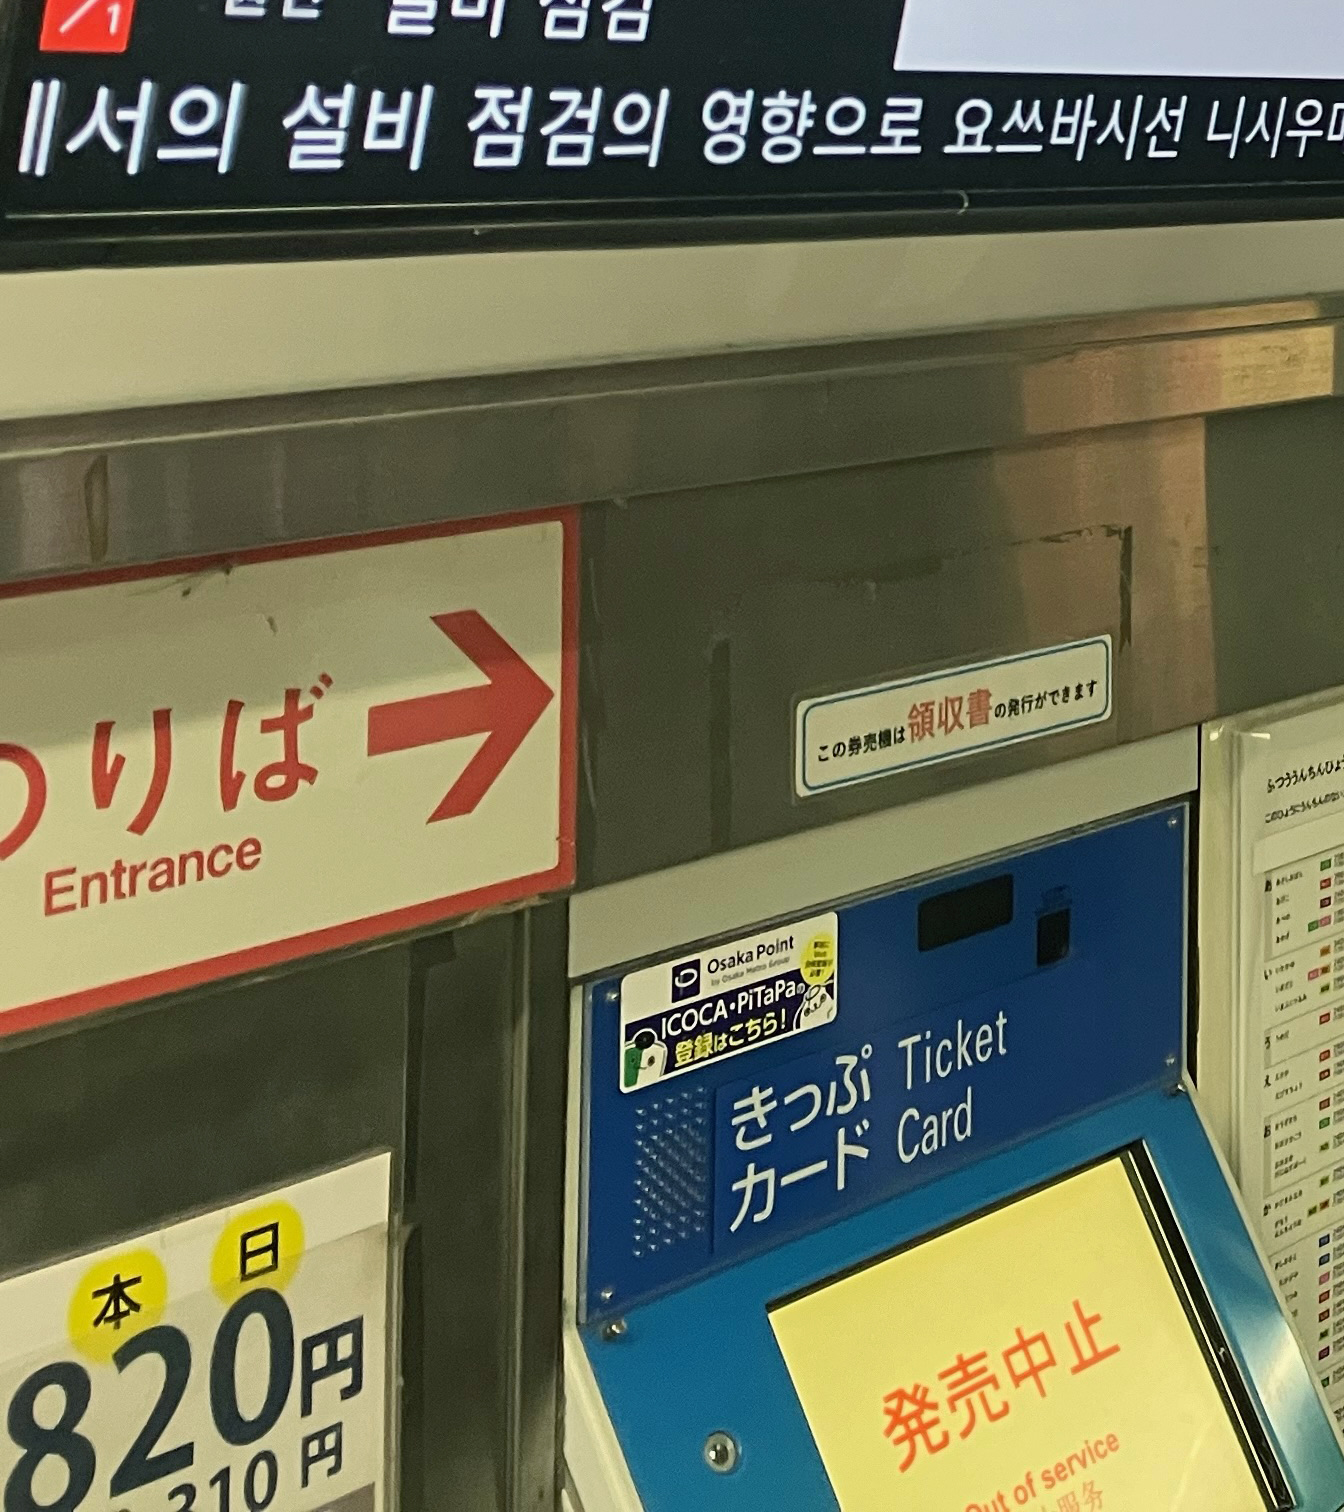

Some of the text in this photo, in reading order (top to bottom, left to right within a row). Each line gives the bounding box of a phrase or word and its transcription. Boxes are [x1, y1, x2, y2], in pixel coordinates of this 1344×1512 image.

[283, 83, 437, 172] 설비
[466, 85, 669, 169] 점검의
[700, 88, 924, 165] 영향으로
[942, 93, 1187, 162] 요쓰바시선
[43, 837, 263, 917] Entrance
[707, 950, 753, 974] Osaka
[757, 935, 794, 960] Point
[731, 1010, 1008, 1151] きっぷ Ticket
[731, 1087, 973, 1232] カード Card
[882, 1299, 1121, 1473] 発売中止
[1014, 1471, 1036, 1505] of
[1041, 1433, 1120, 1489] service
[1042, 1480, 1103, 1512] 服务
